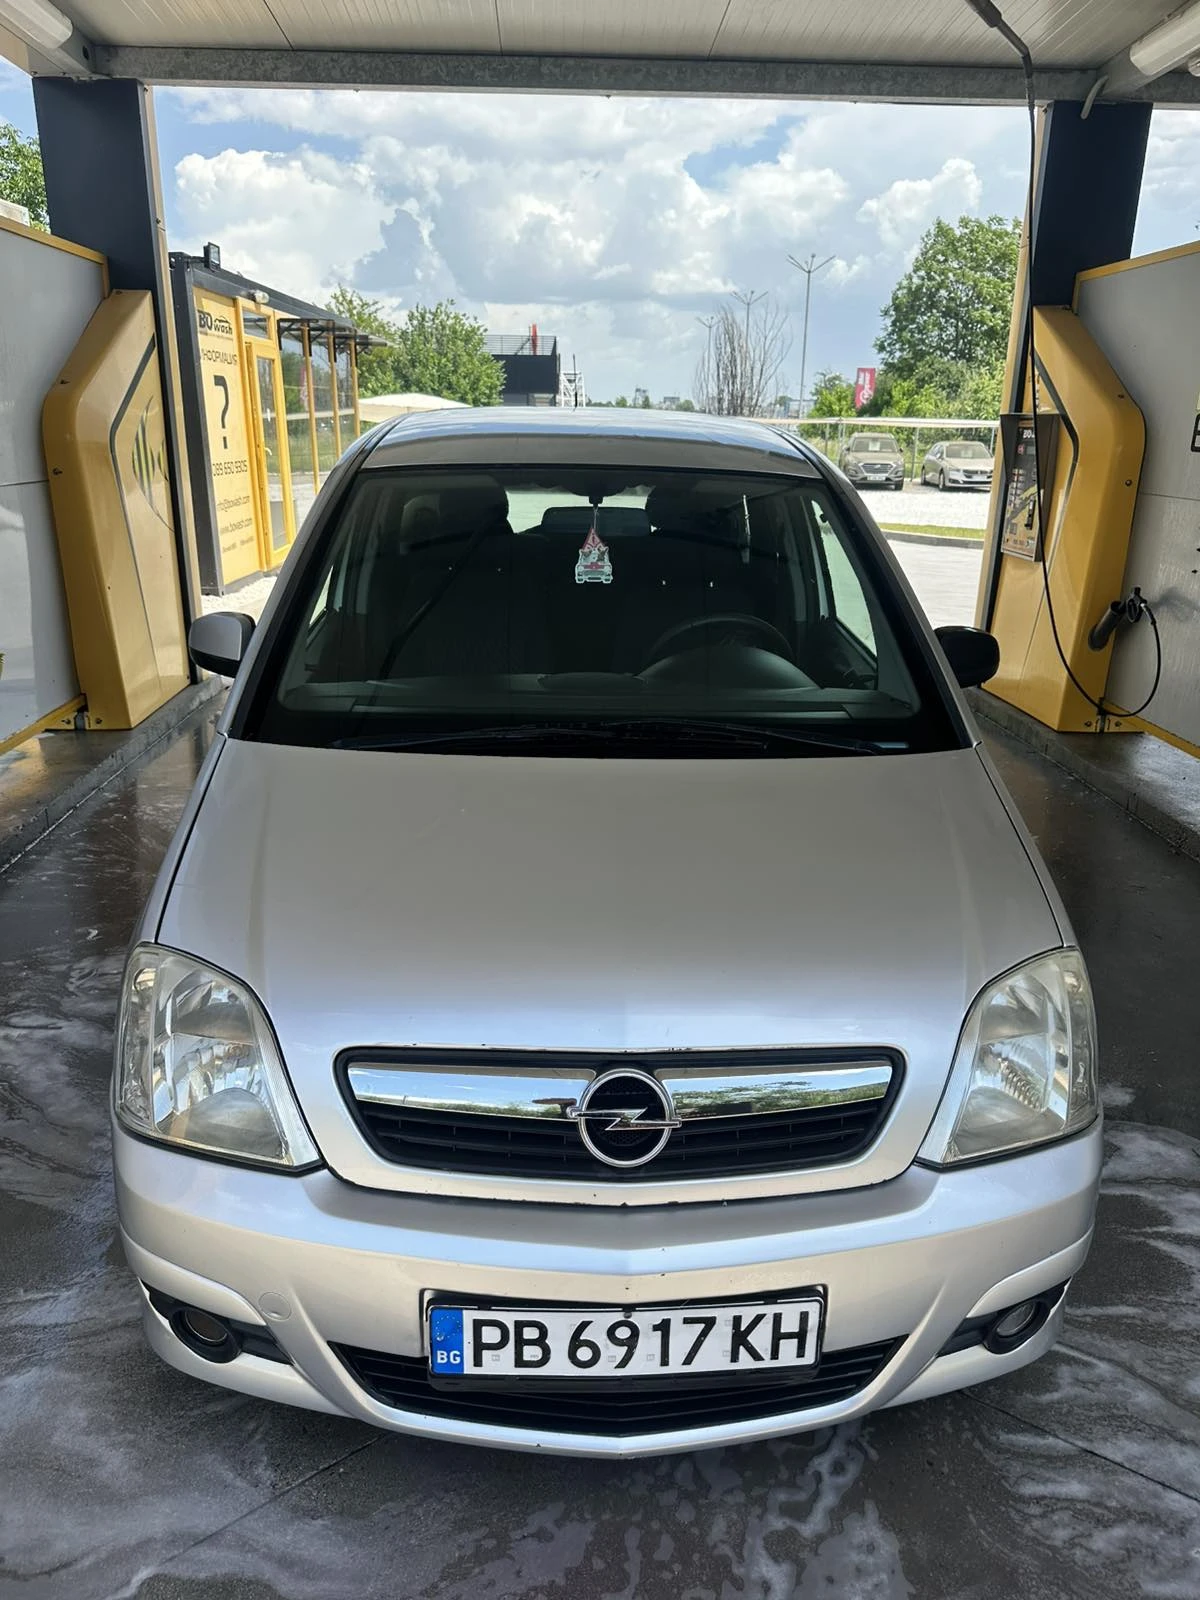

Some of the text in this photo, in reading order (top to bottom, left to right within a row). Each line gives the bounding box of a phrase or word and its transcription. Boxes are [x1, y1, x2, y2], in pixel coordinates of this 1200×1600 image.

[214, 322, 233, 335] wash
[472, 1311, 811, 1370] PB 6917 KH
[436, 1349, 461, 1365] BG
